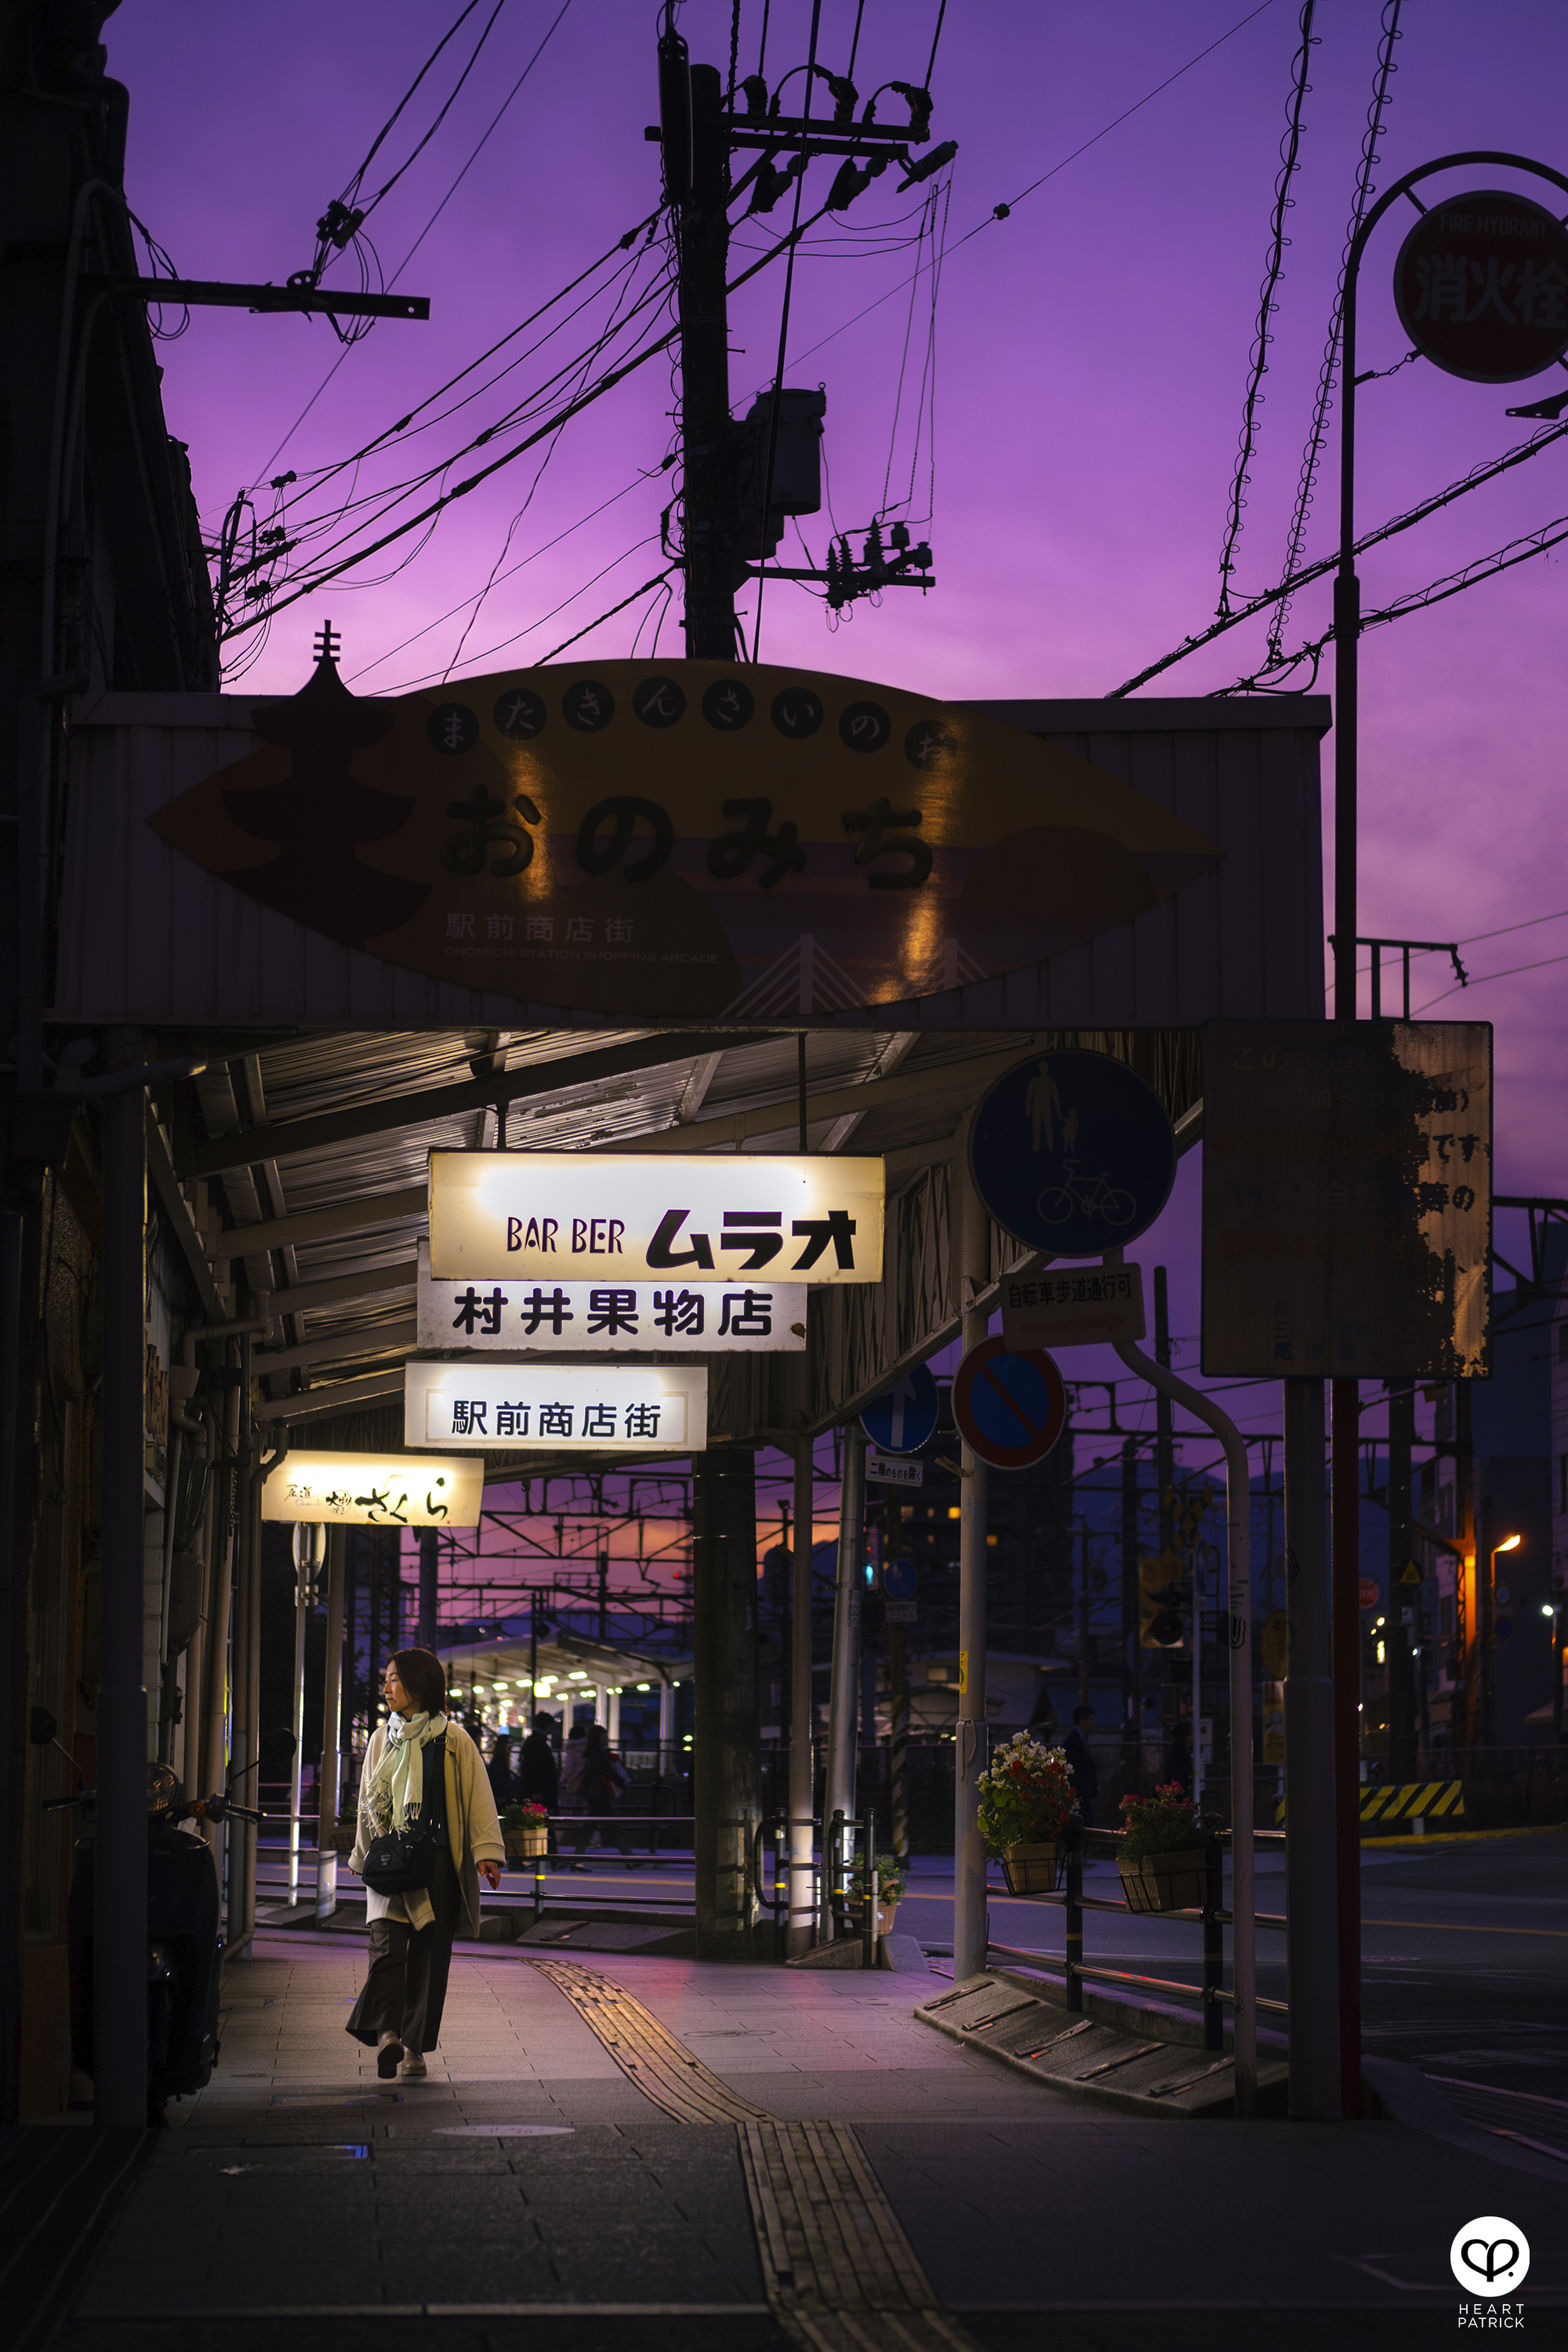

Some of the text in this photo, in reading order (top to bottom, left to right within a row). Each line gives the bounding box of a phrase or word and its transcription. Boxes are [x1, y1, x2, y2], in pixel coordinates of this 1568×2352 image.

[1441, 213, 1548, 238] FIRE HYDRANT
[1414, 252, 1568, 329] 消火栓
[441, 783, 934, 890] おのみち
[445, 913, 635, 944] 駅前商店街
[443, 946, 517, 958] ONOMICHI
[518, 948, 580, 960] STATION
[659, 953, 719, 964] ARCADE
[507, 1209, 857, 1271] BAR BER ムラオ
[1009, 1273, 1131, 1308] 自転車歩道通行可
[452, 1287, 774, 1338] 村井果物店
[451, 1399, 661, 1439] 駅前商店街
[869, 1461, 921, 1482] 二輪のものを除く
[354, 1477, 448, 1523] さくら
